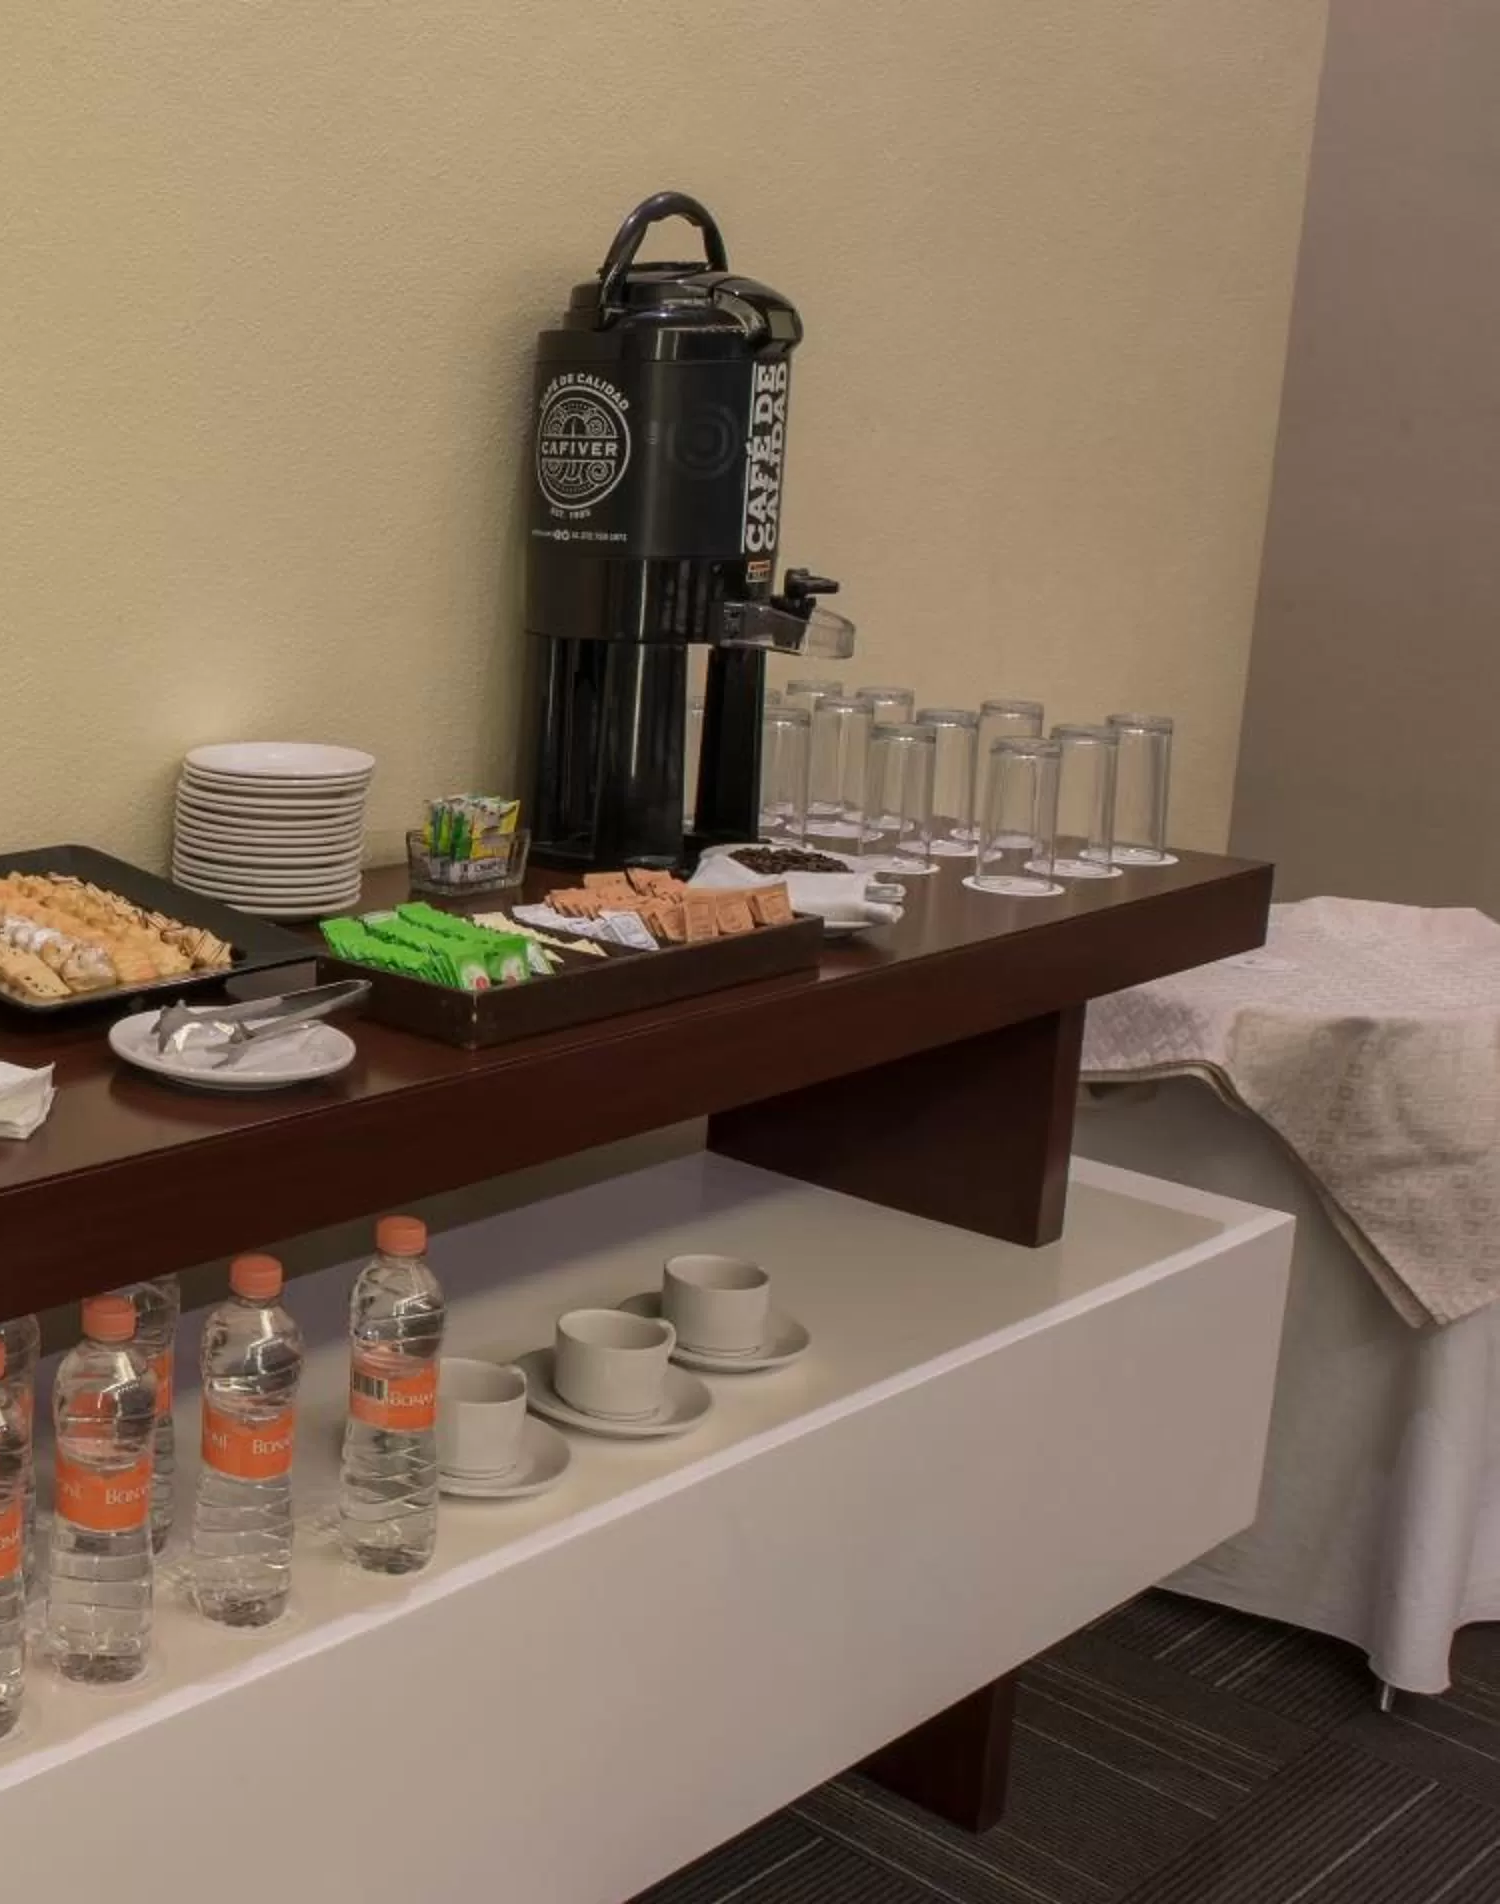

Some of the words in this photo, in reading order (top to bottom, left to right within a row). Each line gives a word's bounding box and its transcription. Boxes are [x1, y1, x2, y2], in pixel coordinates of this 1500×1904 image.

[577, 372, 629, 411] CALIDAD
[755, 366, 776, 425] DE
[541, 441, 618, 457] CAFIVER
[765, 363, 788, 550] CALIDAD
[745, 434, 771, 551] CAFÉ
